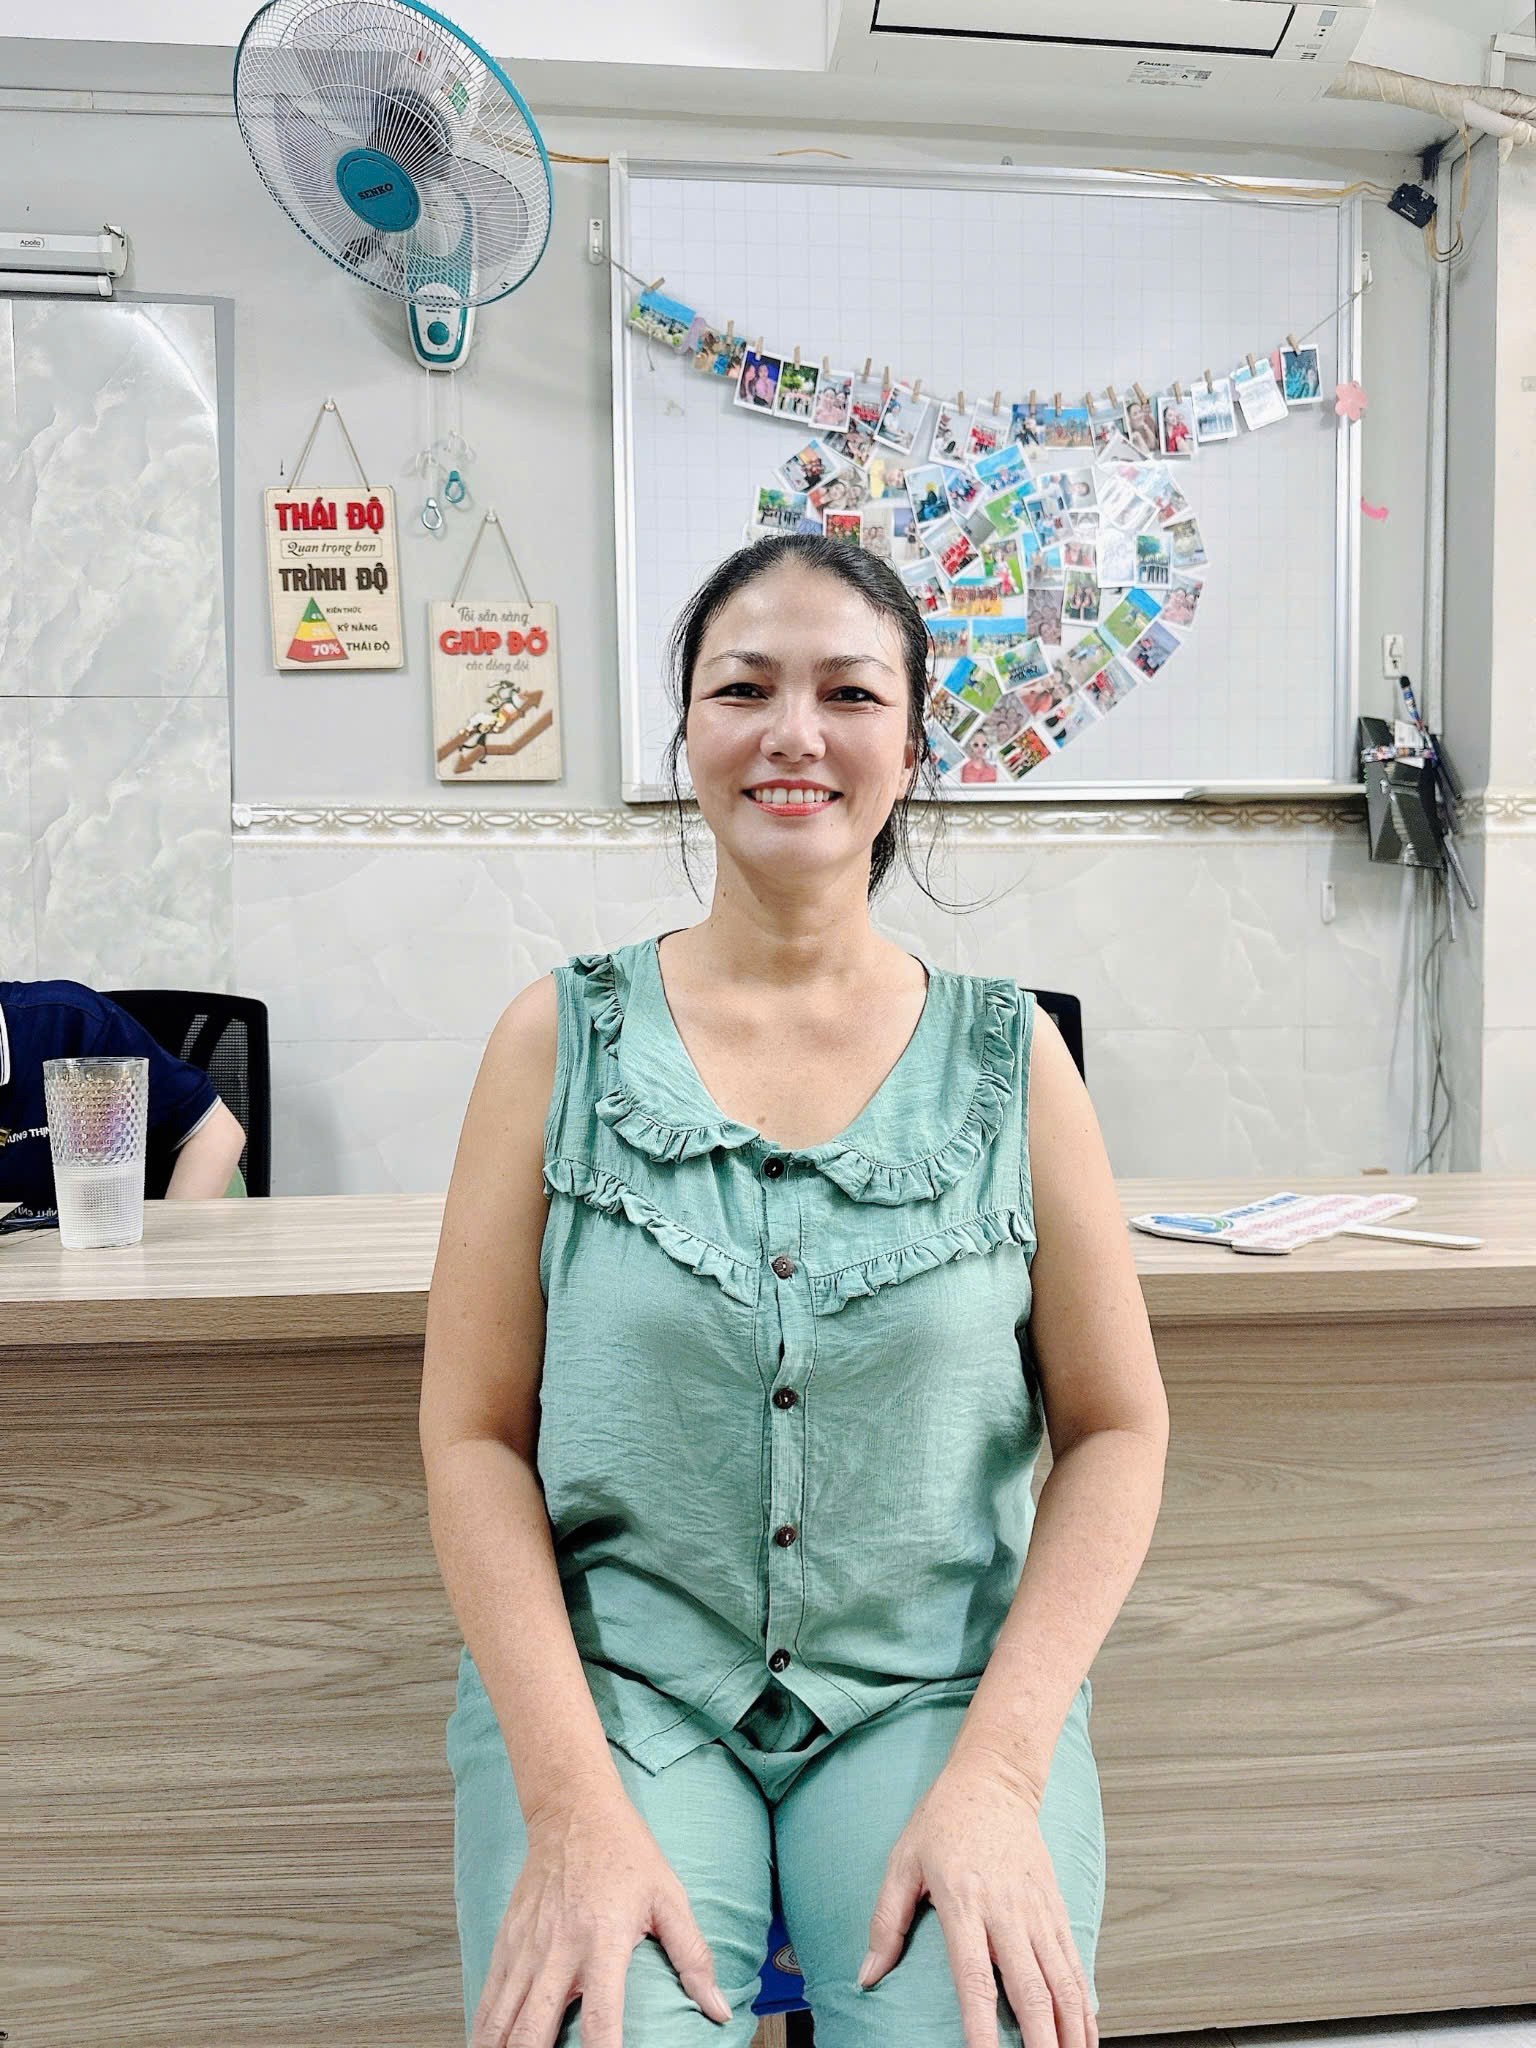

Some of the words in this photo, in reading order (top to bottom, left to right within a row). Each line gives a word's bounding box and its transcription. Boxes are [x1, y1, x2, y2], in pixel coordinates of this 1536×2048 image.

[357, 183, 393, 200] SENKO
[274, 496, 338, 531] THÁI
[345, 496, 384, 534] ĐỘ
[287, 541, 318, 557] Quan
[321, 543, 352, 556] trọng
[278, 563, 346, 591] TRÌNH
[356, 562, 388, 594] ĐỘ
[458, 606, 474, 622] Tôi
[311, 643, 341, 656] 70%
[346, 641, 371, 651] THÁI
[374, 641, 390, 653] ĐỘ
[439, 627, 502, 656] GIÚP
[507, 626, 548, 657] ĐỠ
